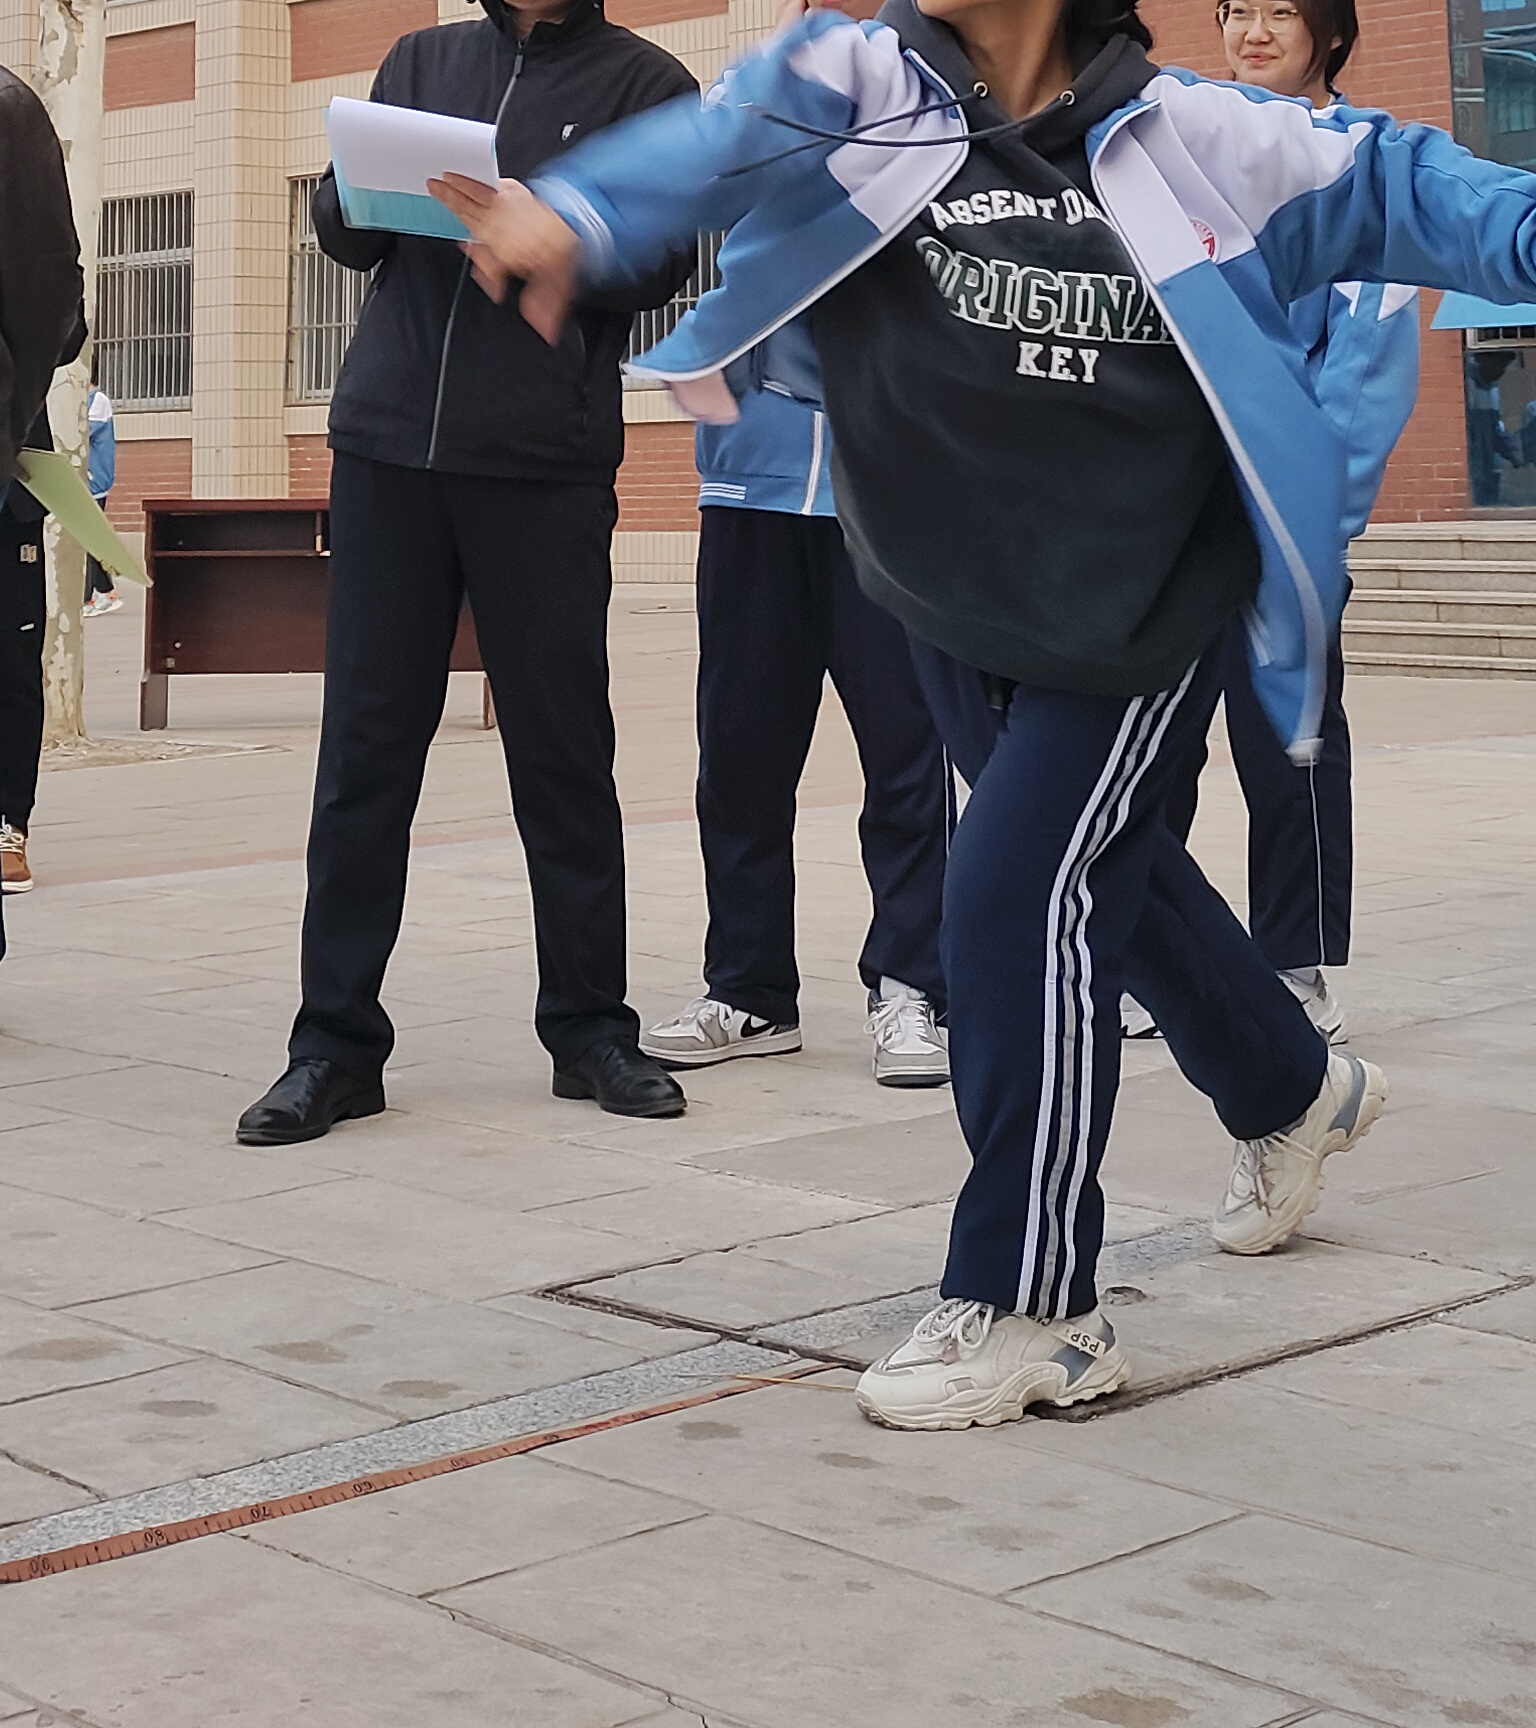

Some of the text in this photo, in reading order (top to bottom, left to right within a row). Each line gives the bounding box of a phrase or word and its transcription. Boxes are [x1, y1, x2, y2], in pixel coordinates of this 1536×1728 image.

[928, 190, 1057, 230] ABSENT
[915, 235, 1176, 345] ORIGINA
[1016, 341, 1099, 383] KEY
